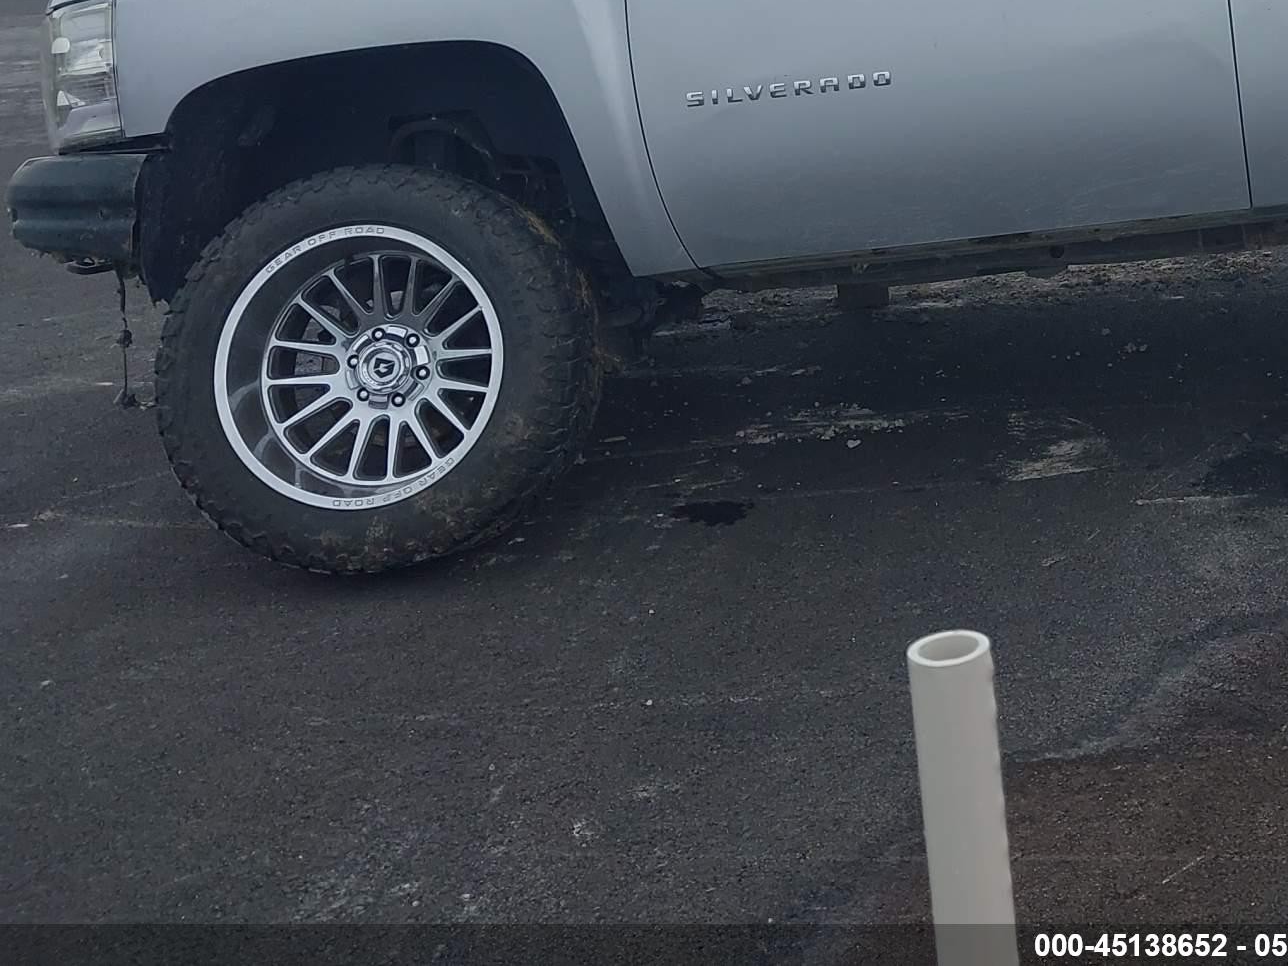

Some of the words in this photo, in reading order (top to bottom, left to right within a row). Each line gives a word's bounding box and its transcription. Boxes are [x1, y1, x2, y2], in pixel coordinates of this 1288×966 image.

[686, 70, 891, 107] SILVERADO
[265, 245, 301, 274] GEAR
[307, 231, 337, 246] OFF
[344, 227, 385, 235] ROAD
[419, 457, 455, 486] GEAR
[332, 498, 375, 507] ROAD
[382, 486, 413, 503] OFF
